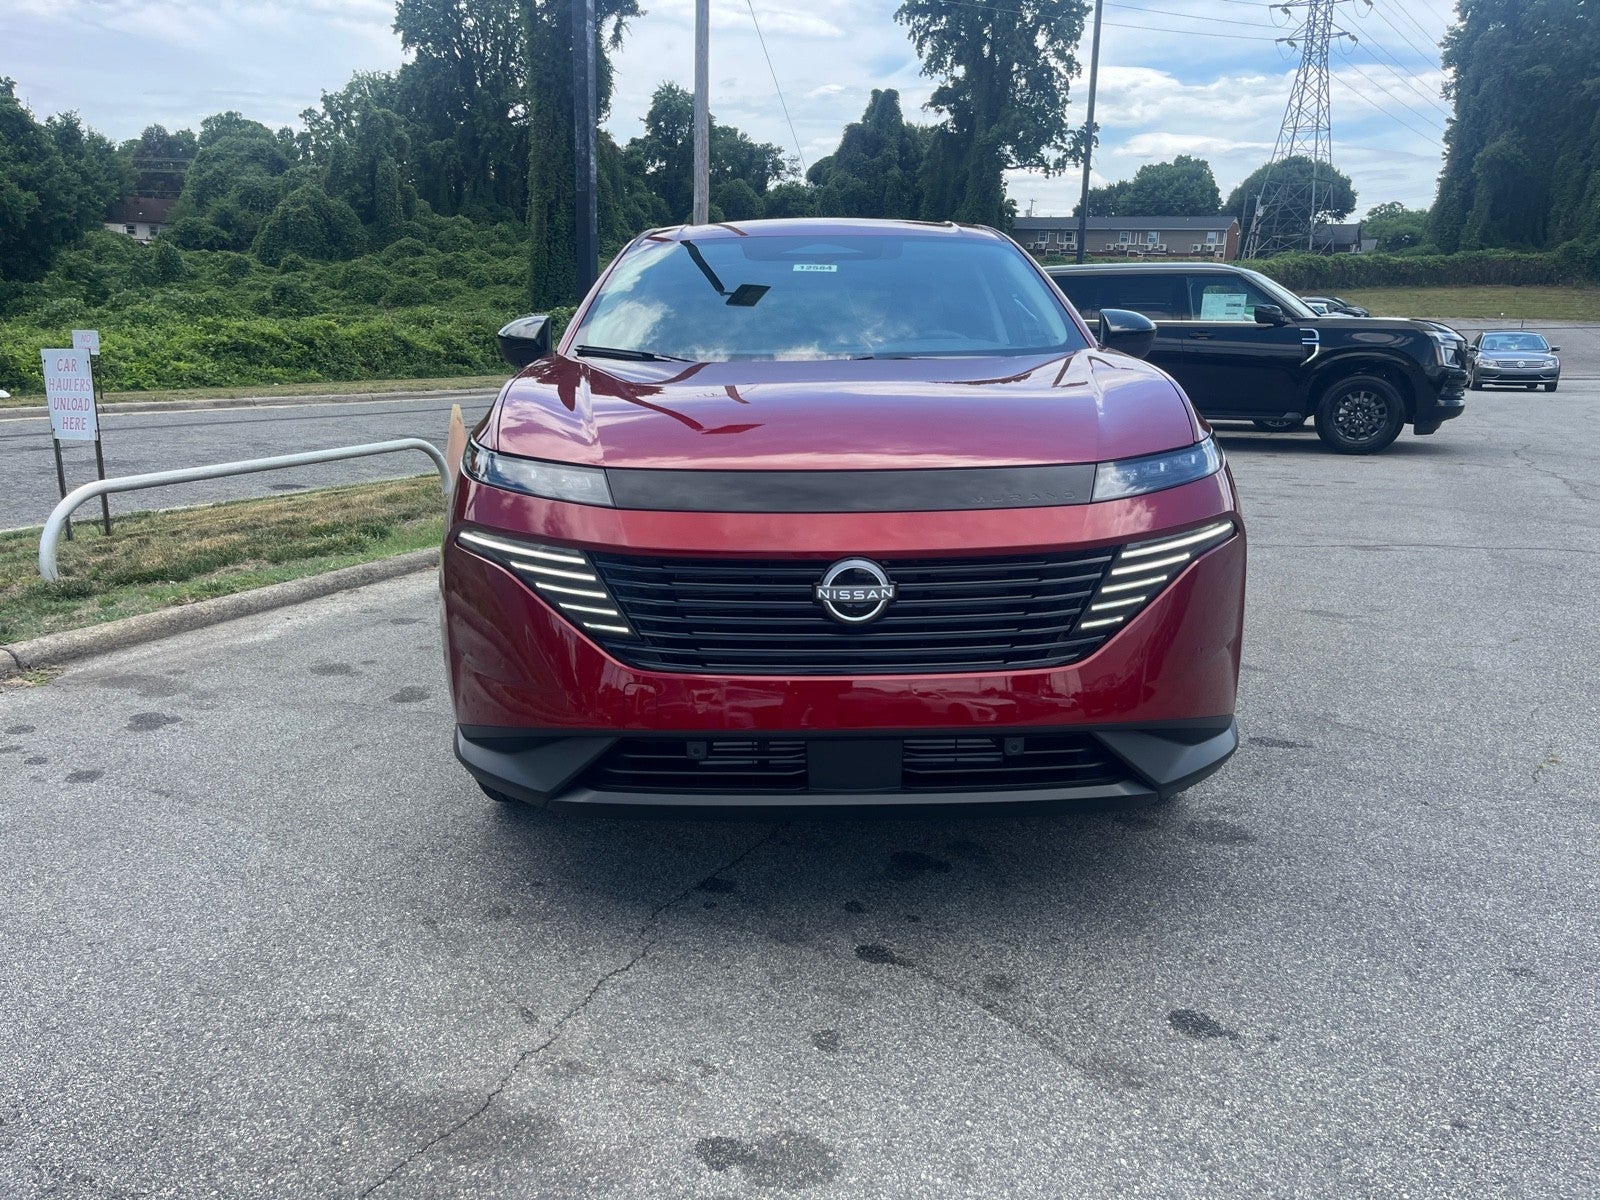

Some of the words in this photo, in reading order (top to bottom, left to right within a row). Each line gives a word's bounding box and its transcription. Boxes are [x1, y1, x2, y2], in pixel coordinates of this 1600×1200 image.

[80, 334, 92, 343] NO
[57, 358, 77, 372] CAR
[48, 378, 91, 391] HAULERS
[53, 398, 90, 411] UNLOAD
[62, 417, 87, 430] HERE
[818, 588, 893, 600] NISSAN
